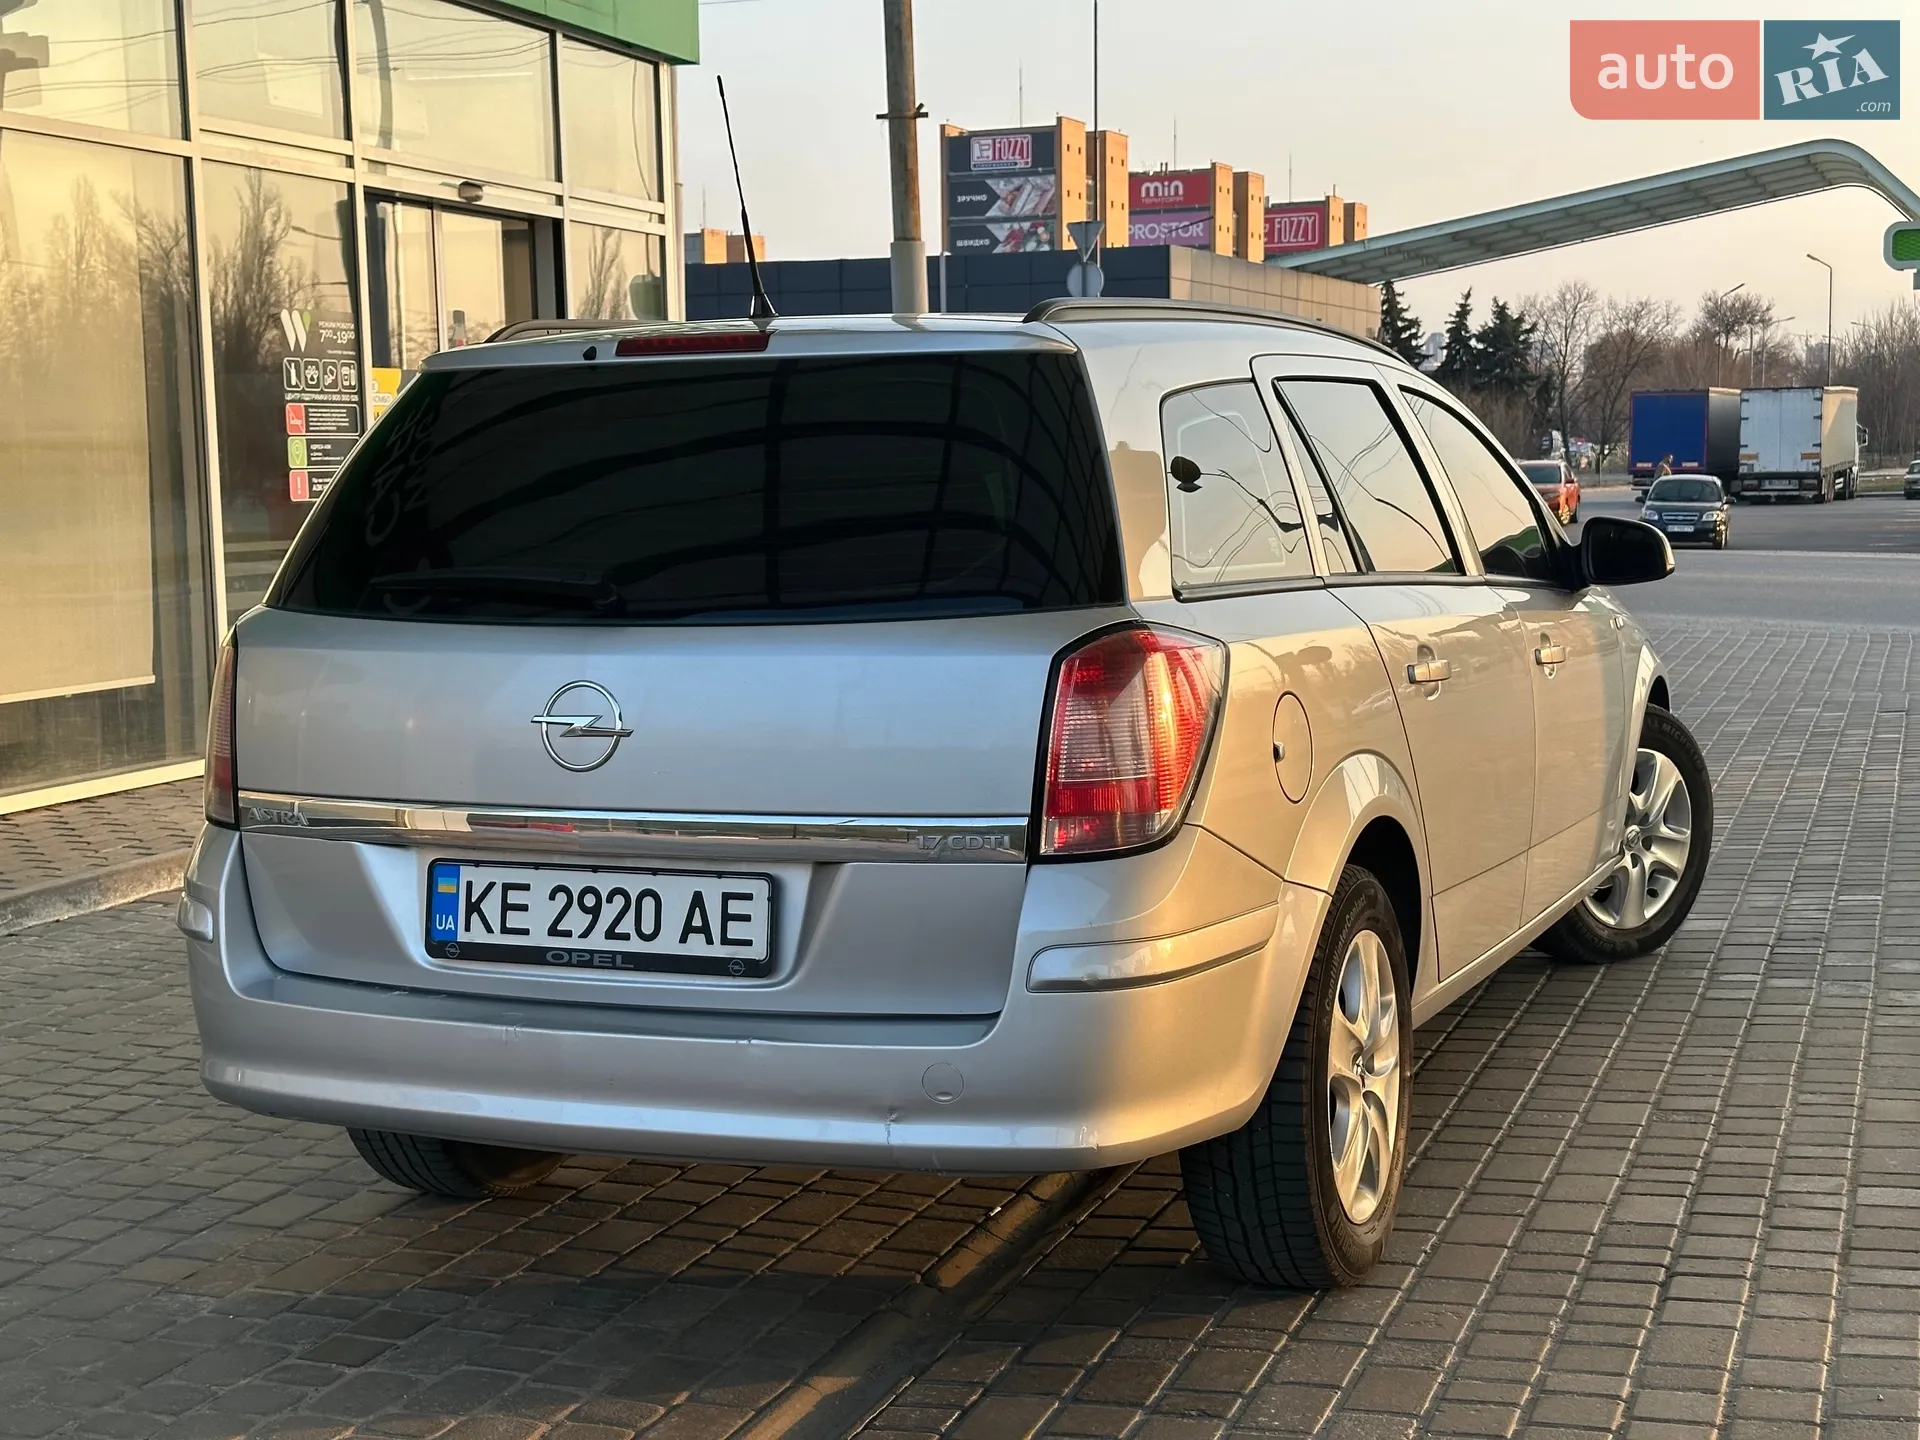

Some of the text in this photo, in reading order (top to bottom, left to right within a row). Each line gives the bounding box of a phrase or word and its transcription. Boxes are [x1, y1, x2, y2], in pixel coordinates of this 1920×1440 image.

[995, 138, 1029, 160] FOZZY
[956, 194, 988, 203] ЗРУЧНО
[1141, 180, 1184, 198] min
[1128, 221, 1204, 240] PROSTOR
[1274, 216, 1315, 243] FOZZY
[956, 238, 991, 247] ШВИДКО
[248, 807, 310, 826] ASTRA
[947, 835, 1010, 850] CDTI
[435, 914, 456, 931] UA
[464, 880, 754, 947] KE 2920 AE
[545, 950, 634, 969] OPEL
